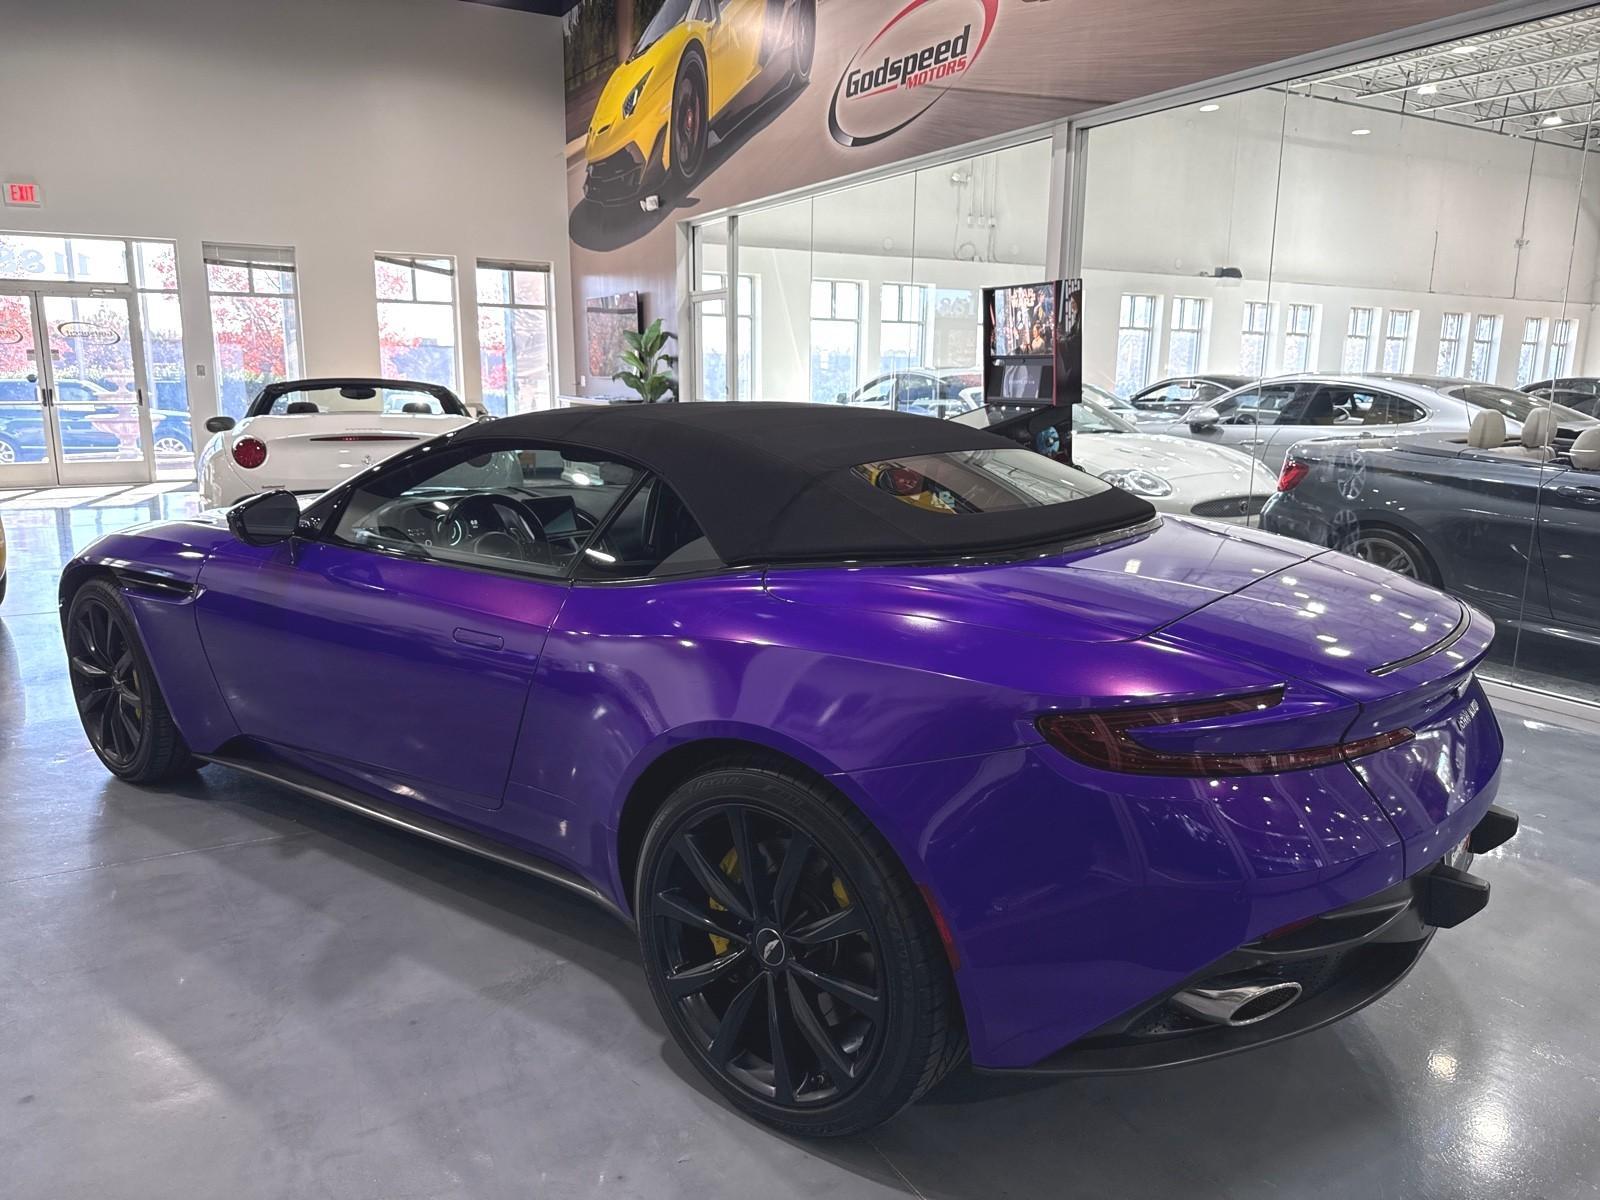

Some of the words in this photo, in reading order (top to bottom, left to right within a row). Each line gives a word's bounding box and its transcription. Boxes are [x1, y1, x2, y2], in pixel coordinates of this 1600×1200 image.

[845, 24, 971, 98] Godspeed
[905, 56, 968, 90] MOTORS
[10, 184, 35, 202] EXIT
[1011, 288, 1035, 298] STAR
[1011, 297, 1036, 307] WARS
